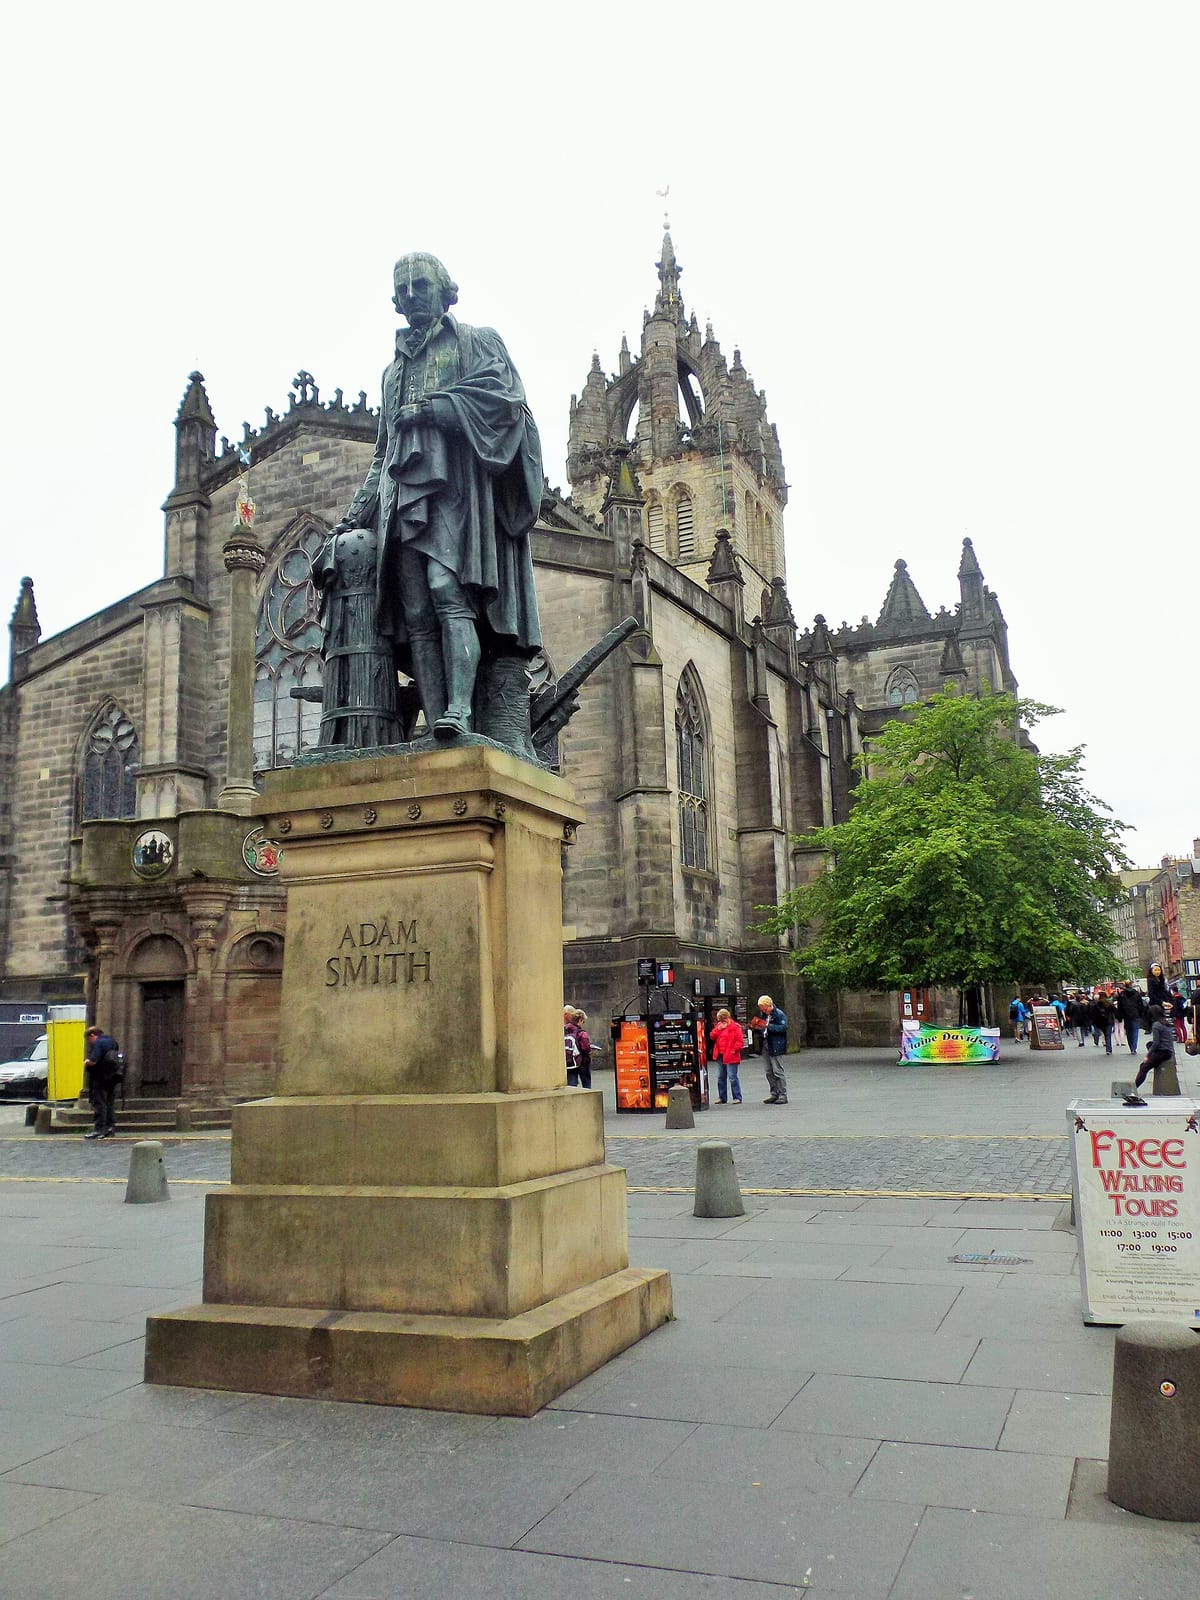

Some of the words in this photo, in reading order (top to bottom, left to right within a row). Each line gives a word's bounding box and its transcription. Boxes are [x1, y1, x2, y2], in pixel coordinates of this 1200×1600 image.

[338, 919, 417, 949] ADAM
[325, 950, 432, 987] SMITH
[1089, 1129, 1187, 1170] FREE
[1099, 1170, 1184, 1193] WALKING
[1108, 1194, 1179, 1218] TOURS
[1133, 1230, 1157, 1239] 13:00
[1168, 1231, 1193, 1240] 15:00
[1117, 1243, 1141, 1252] 17:00
[1152, 1244, 1177, 1253] 19:00
